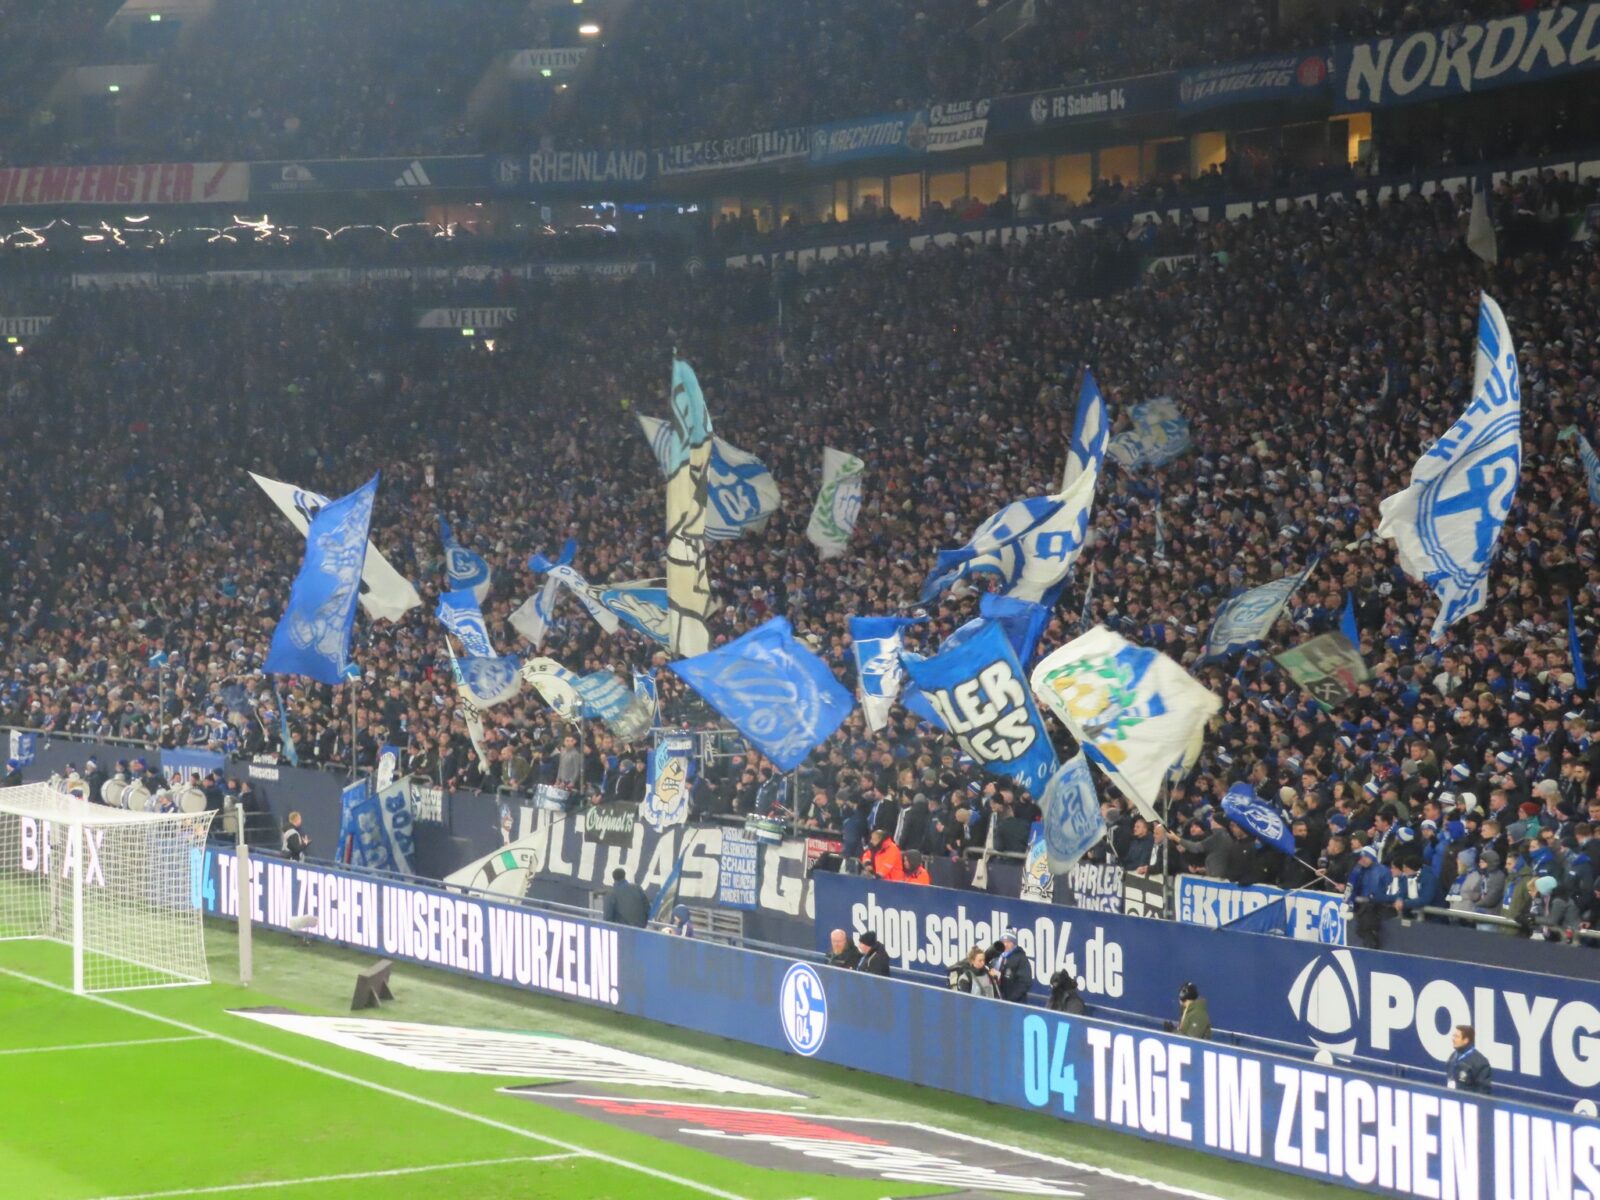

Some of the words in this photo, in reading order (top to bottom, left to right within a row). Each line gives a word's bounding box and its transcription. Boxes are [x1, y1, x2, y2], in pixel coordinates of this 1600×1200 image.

[1053, 96, 1065, 117] FC
[1067, 92, 1108, 116] Schalke
[1110, 88, 1125, 110] 04
[529, 151, 647, 184] RHEINLAND
[720, 857, 757, 874] SCHALKE
[218, 853, 264, 923] TAE
[267, 863, 293, 929] IM
[297, 870, 378, 948] ZEICHEN
[382, 886, 484, 975] UNSERER
[489, 906, 619, 1006] WURZELN!
[1023, 1014, 1078, 1113] 04
[1087, 1027, 1193, 1141] TAGE
[1203, 1050, 1262, 1157] IM
[1273, 1064, 1479, 1200] ZEICHEN
